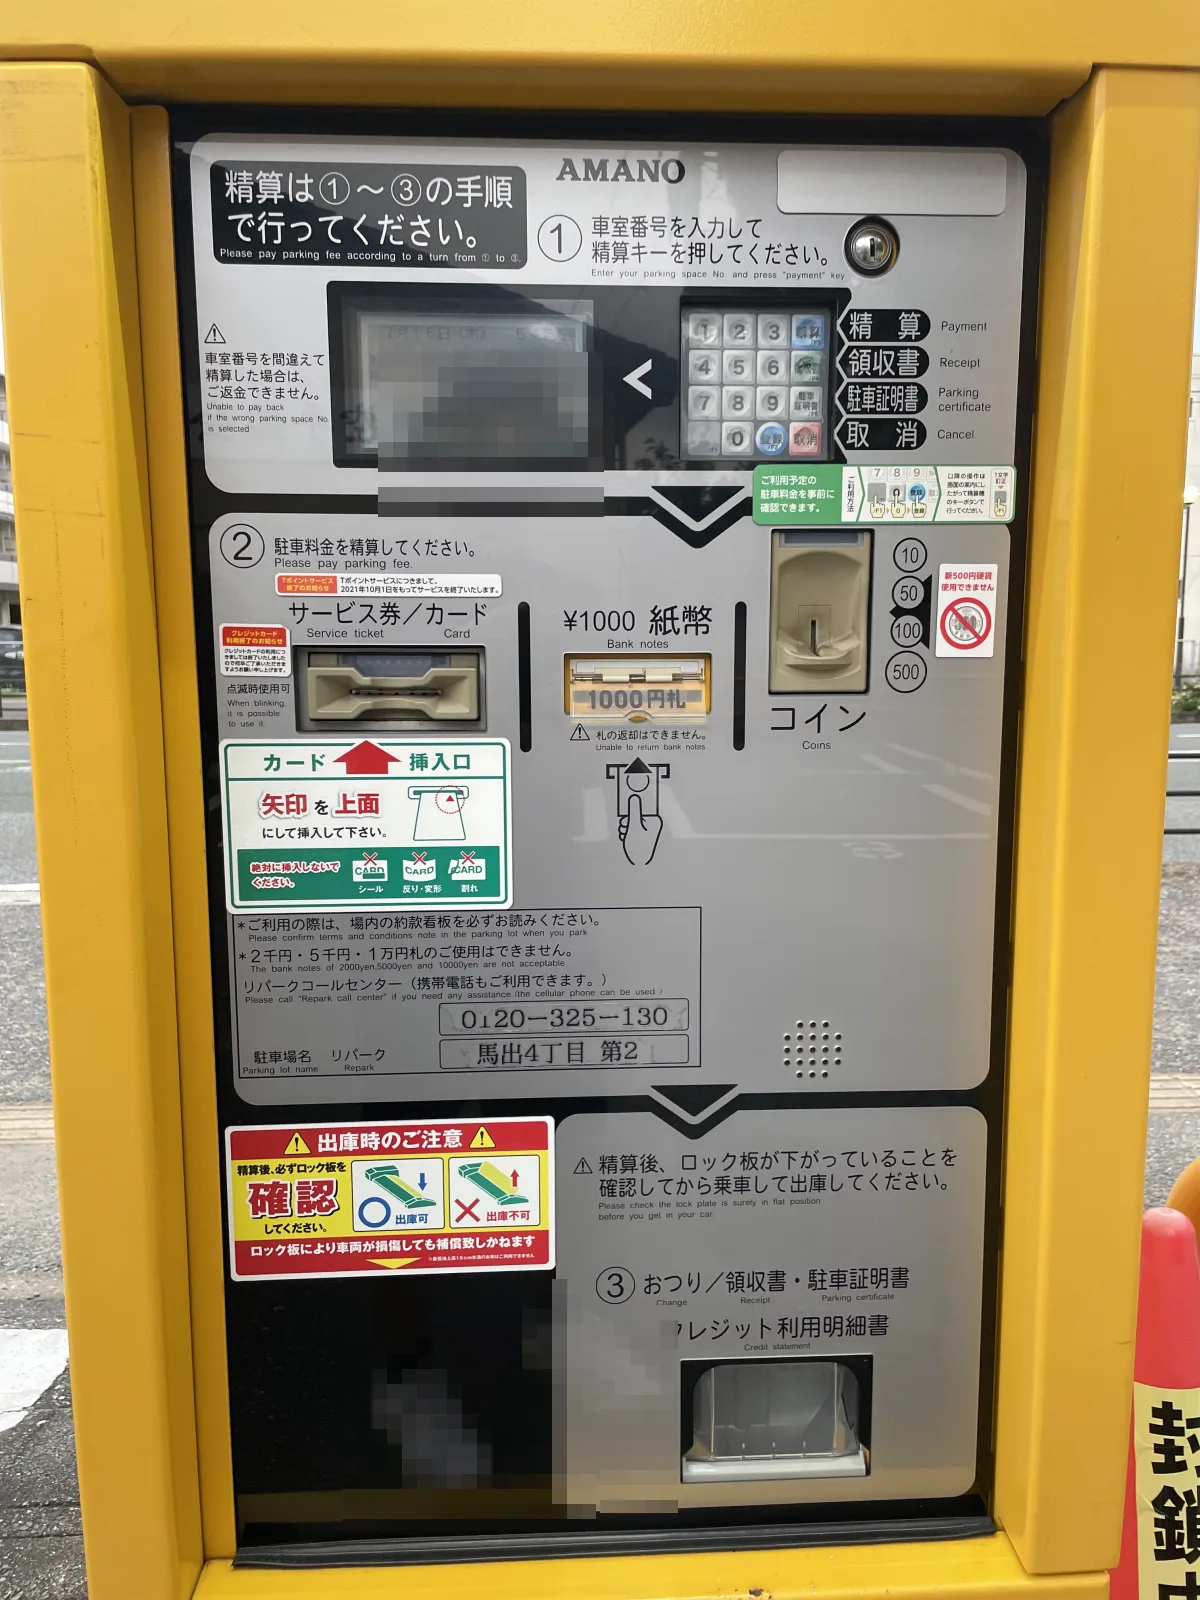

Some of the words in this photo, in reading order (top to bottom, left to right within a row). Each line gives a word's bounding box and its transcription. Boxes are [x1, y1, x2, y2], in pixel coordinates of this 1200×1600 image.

[556, 158, 685, 184] AMANO
[228, 211, 476, 248] で行ってください。
[592, 215, 763, 239] 車室番号を入力して
[220, 249, 252, 258] Please
[259, 251, 276, 260] pay
[282, 250, 320, 260] parking
[326, 251, 341, 260] fee
[348, 252, 396, 262] according
[402, 252, 411, 261] to
[430, 254, 448, 262] turn
[454, 253, 476, 262] from
[592, 242, 829, 266] 精算キーを押してください。
[592, 269, 614, 277] Enter
[644, 270, 676, 279] parking
[682, 271, 707, 279] space
[754, 272, 777, 280] press
[734, 324, 745, 339] 2
[769, 324, 780, 340] 3
[941, 322, 987, 332] Payment
[205, 352, 324, 366] 車室番号を間違えて
[849, 349, 920, 376] 領収書
[940, 358, 980, 368] Receipt
[698, 360, 710, 375] 4
[734, 360, 744, 375] 5
[768, 360, 779, 375] 6
[206, 369, 304, 383] 精算した場合は、
[208, 386, 319, 400] ご返金できません。
[847, 385, 919, 413] 駐車証明書
[939, 387, 979, 400] Parking
[249, 404, 262, 412] pay
[699, 396, 710, 410] 7
[732, 396, 744, 411] 8
[767, 396, 778, 411] 9
[938, 401, 991, 412] certificate
[260, 415, 287, 423] parking
[732, 432, 743, 446] 0
[937, 429, 975, 440] Cancel
[761, 475, 817, 485] ご利用予定の
[760, 489, 834, 500] 駐車料金を事前に
[760, 503, 821, 513] 確認できます。
[274, 538, 475, 558] 駐車料金を精算してください。
[902, 547, 919, 563] 10
[274, 558, 311, 568] Please
[318, 559, 338, 570] pay
[345, 558, 386, 570] parking
[393, 559, 413, 569] fee.
[900, 585, 918, 601] 50
[564, 610, 635, 631] ¥1000
[649, 605, 712, 636] 紙幣
[307, 628, 348, 639] Service
[355, 628, 384, 639] ticket
[444, 628, 471, 639] Card
[894, 622, 920, 639] 100
[607, 639, 634, 649] Bank
[640, 640, 669, 649] notes
[893, 664, 919, 680] 500
[227, 684, 290, 694] 点滅時使用可
[588, 689, 686, 709] 1000円札
[771, 704, 866, 733] コイン
[596, 730, 706, 741] 札の返却はできません。
[802, 741, 831, 750] Coins
[264, 753, 326, 771] カード
[409, 753, 471, 771] 挿入口
[262, 826, 387, 839] にして挿入して下さい。
[250, 862, 341, 873] 絶対に挿入しないで
[252, 877, 295, 888] ください。
[461, 884, 478, 892] 割れ
[249, 934, 277, 942] Please
[282, 934, 314, 942] confirm
[370, 932, 412, 940] conditions
[471, 930, 503, 939] parking
[523, 929, 545, 937] when
[550, 930, 564, 938] you
[519, 959, 565, 968] acceptable
[245, 996, 273, 1004] Please
[535, 989, 564, 997] cellular
[254, 1051, 311, 1064] 駐車場名
[332, 1049, 386, 1062] リパーク
[477, 1042, 584, 1065] 馬出4丁目
[601, 1040, 638, 1062] 第2
[243, 1067, 275, 1075] Parking
[345, 1064, 374, 1072] Repark
[317, 1130, 463, 1153] 出庫時のご注意
[599, 1148, 958, 1175] 精算後、ロック板が下がっていることを
[237, 1162, 347, 1176] 精算後、必ずロック板を
[599, 1173, 950, 1198] 確認してから乗車して出庫してください。
[247, 1178, 339, 1218] 確認
[599, 1202, 625, 1210] Please
[697, 1200, 717, 1208] plate
[733, 1199, 756, 1208] surely
[790, 1198, 821, 1206] position
[395, 1213, 429, 1225] 出庫可
[486, 1210, 531, 1222] 出庫不可
[599, 1213, 625, 1221] before
[629, 1213, 644, 1221] you
[264, 1222, 328, 1235] してください。
[740, 1296, 771, 1305] Receipt
[821, 1293, 852, 1303] Parking
[856, 1292, 895, 1302] certificate
[744, 1343, 768, 1351] Credit
[773, 1341, 811, 1351] statement
[1149, 1401, 1200, 1600] 封鎖
